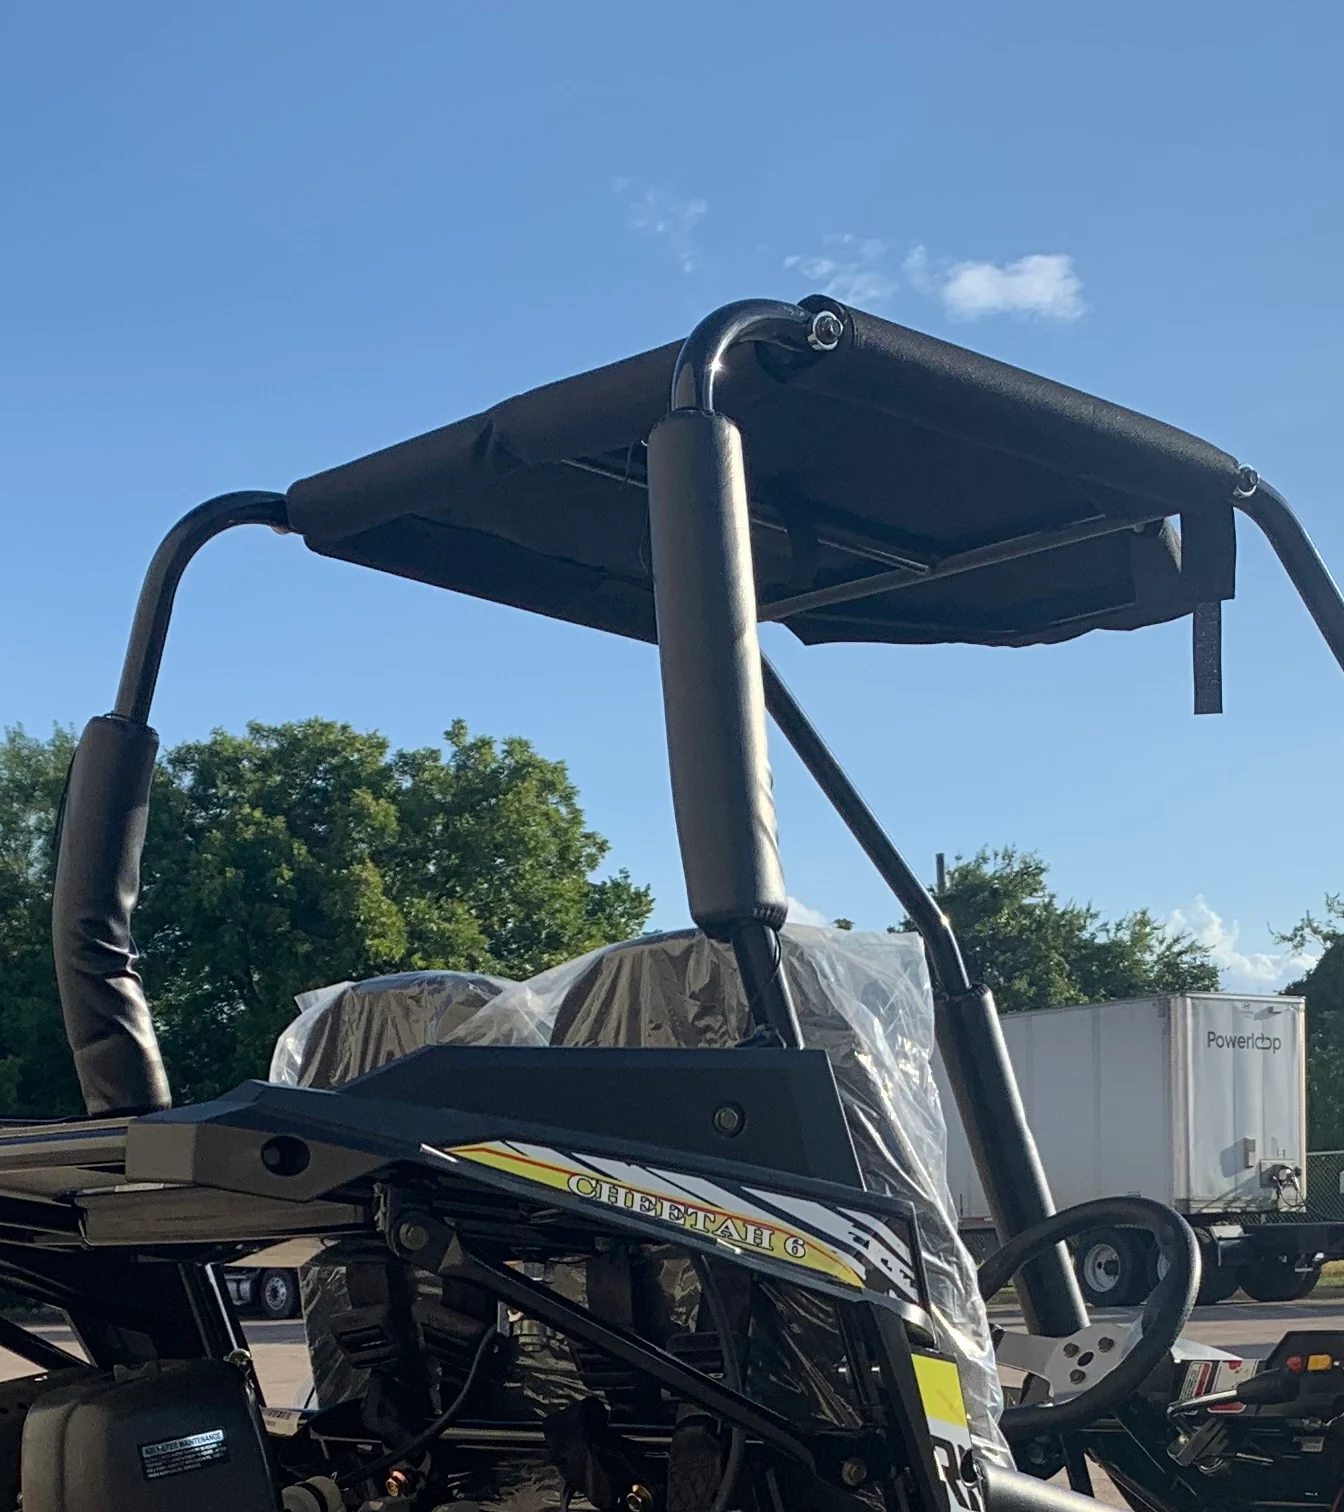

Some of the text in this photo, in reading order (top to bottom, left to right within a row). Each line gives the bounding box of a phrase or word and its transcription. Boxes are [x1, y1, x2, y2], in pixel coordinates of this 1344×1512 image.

[1207, 1031, 1282, 1054] Powerloop
[567, 1173, 807, 1259] CHEETAH 6
